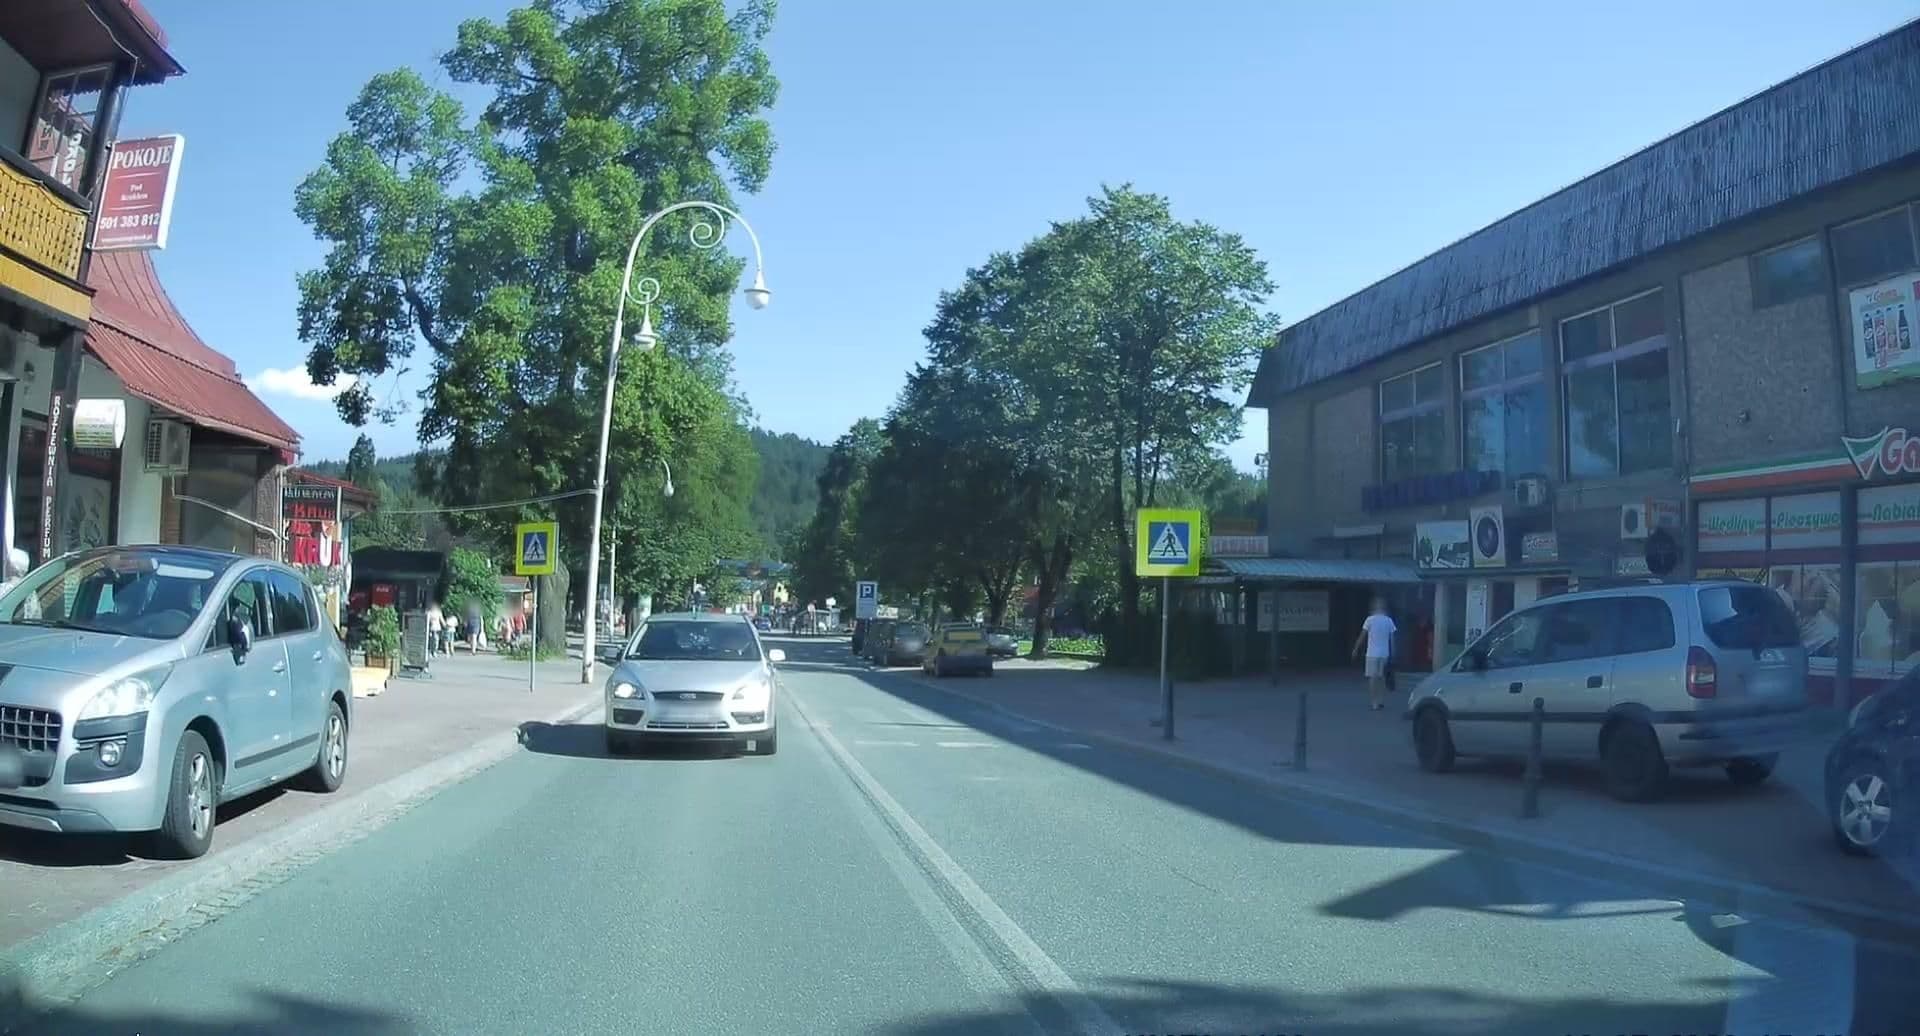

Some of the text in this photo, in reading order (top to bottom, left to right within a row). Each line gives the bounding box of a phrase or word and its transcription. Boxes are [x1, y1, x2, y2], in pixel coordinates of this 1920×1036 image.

[112, 144, 172, 169] POKOJE
[100, 212, 161, 230] 501 383 812
[42, 496, 53, 558] PERFUM
[862, 585, 872, 597] P
